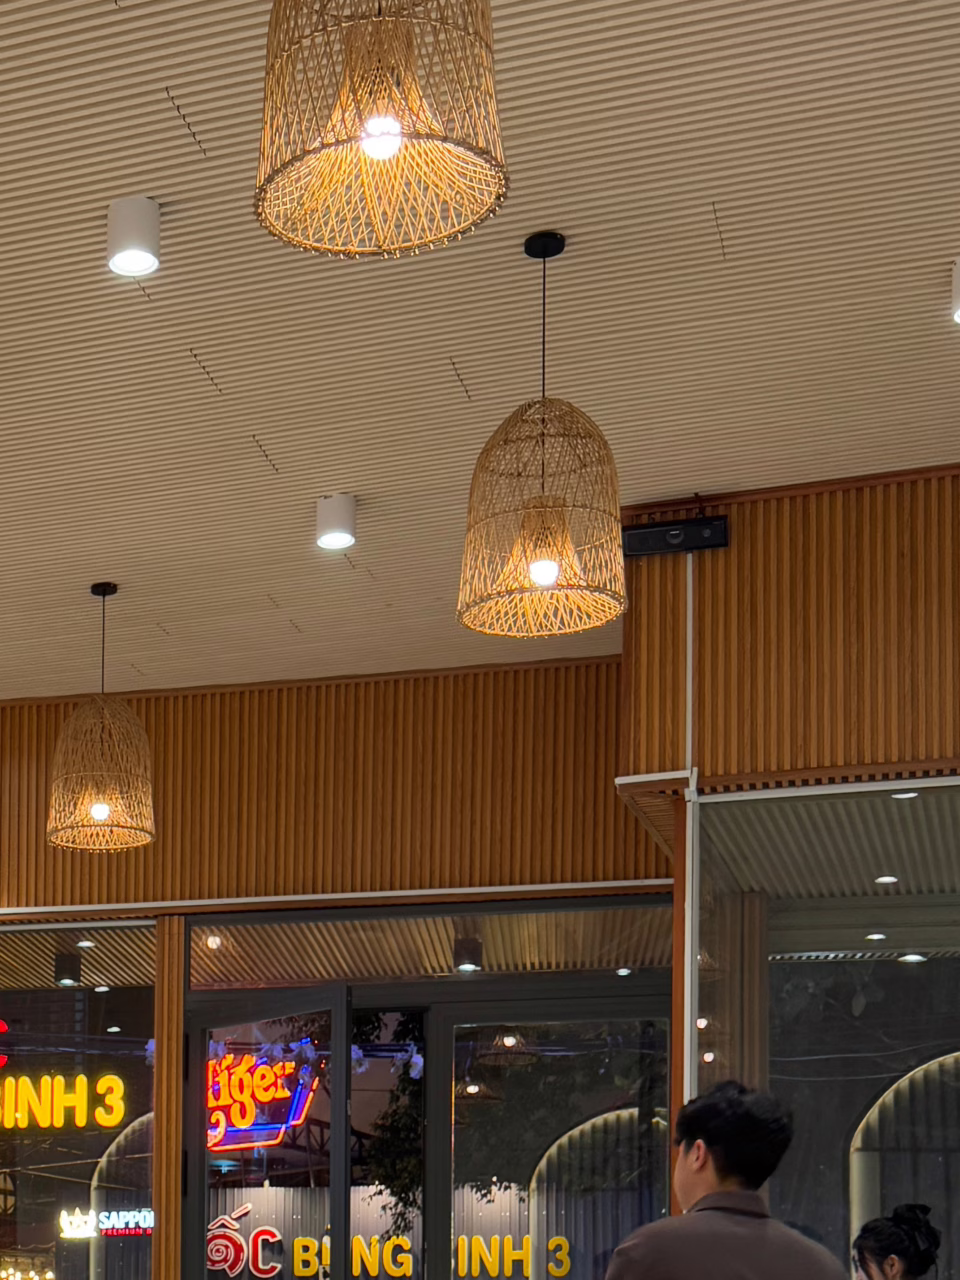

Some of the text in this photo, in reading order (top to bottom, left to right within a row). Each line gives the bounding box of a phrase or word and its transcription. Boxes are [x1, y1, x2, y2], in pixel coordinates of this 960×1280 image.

[94, 1074, 125, 1128] 3
[453, 1234, 531, 1278] INH
[547, 1236, 571, 1278] 3
